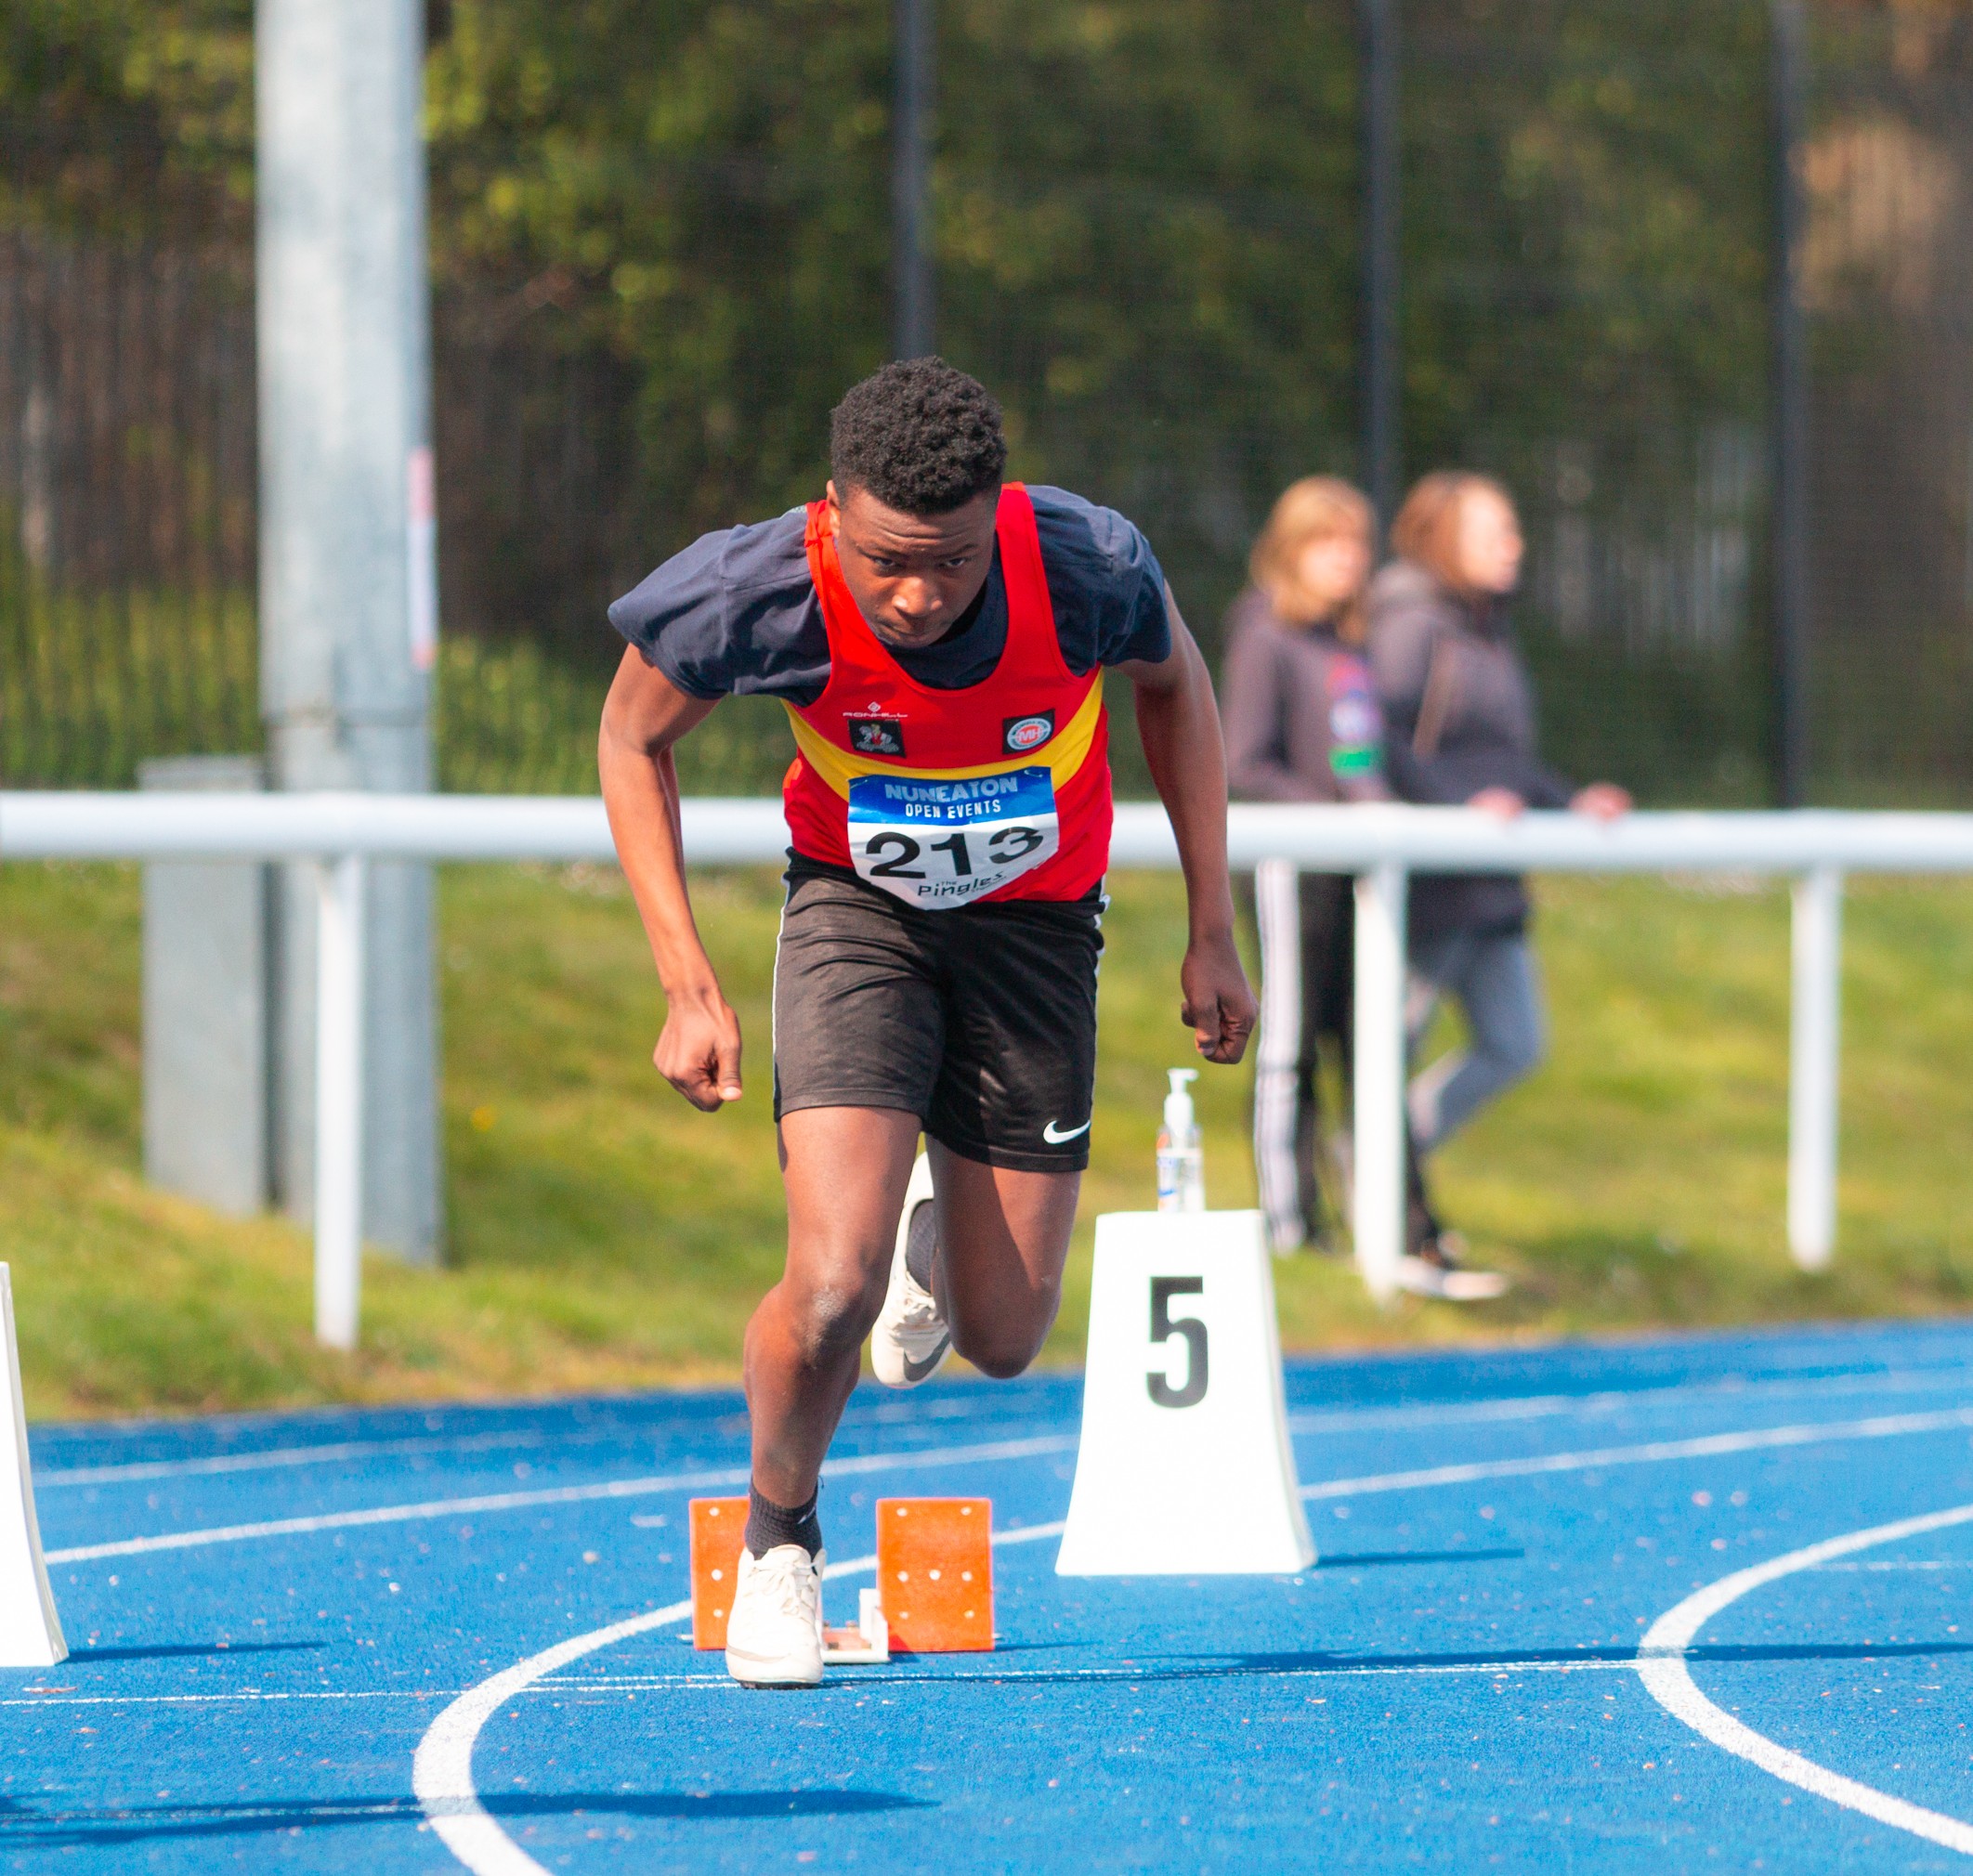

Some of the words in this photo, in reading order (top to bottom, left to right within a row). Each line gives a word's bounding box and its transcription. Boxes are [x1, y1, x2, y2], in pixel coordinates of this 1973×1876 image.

[884, 777, 1017, 803] NUNEATON
[905, 803, 941, 818] OPEN
[947, 800, 1001, 819] EVENTS
[866, 827, 1044, 879] 213
[918, 871, 1003, 896] Pingles
[1146, 1276, 1209, 1407] 5
